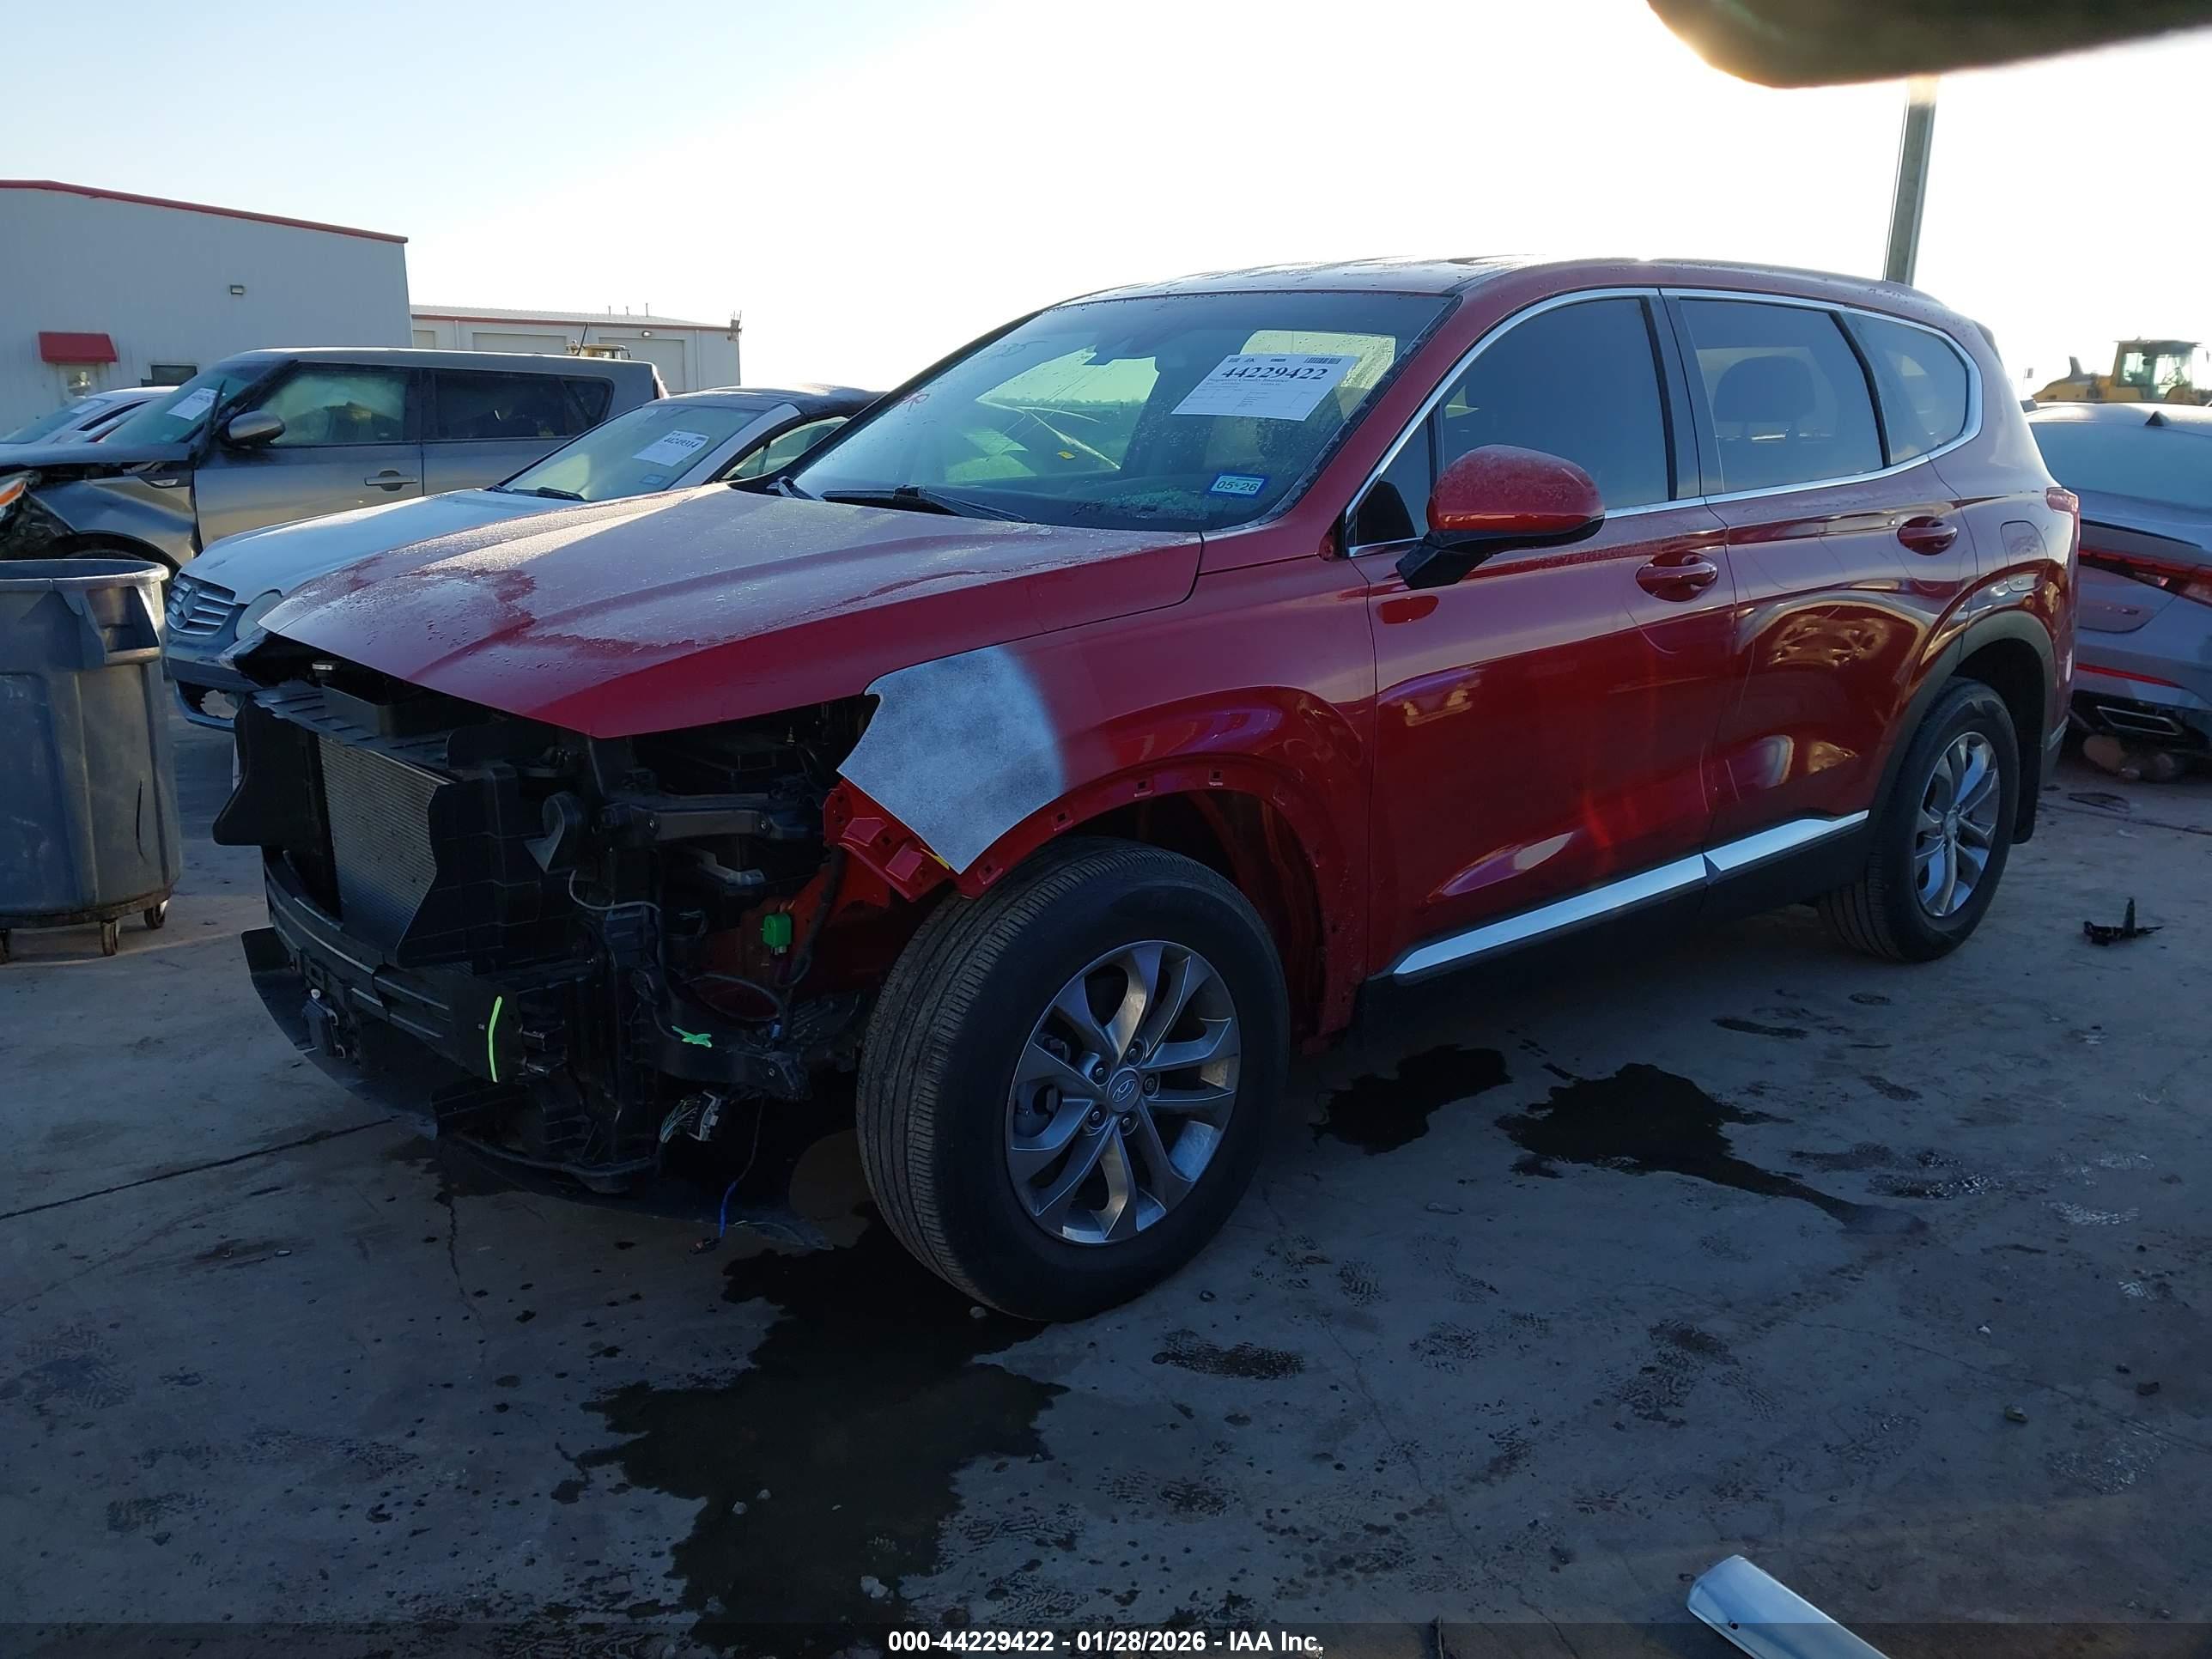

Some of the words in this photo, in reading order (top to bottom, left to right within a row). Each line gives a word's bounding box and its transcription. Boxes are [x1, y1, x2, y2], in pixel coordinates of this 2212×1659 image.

[1222, 366, 1328, 380] 44229422
[1216, 480, 1235, 489] 05
[1239, 483, 1259, 492] 26
